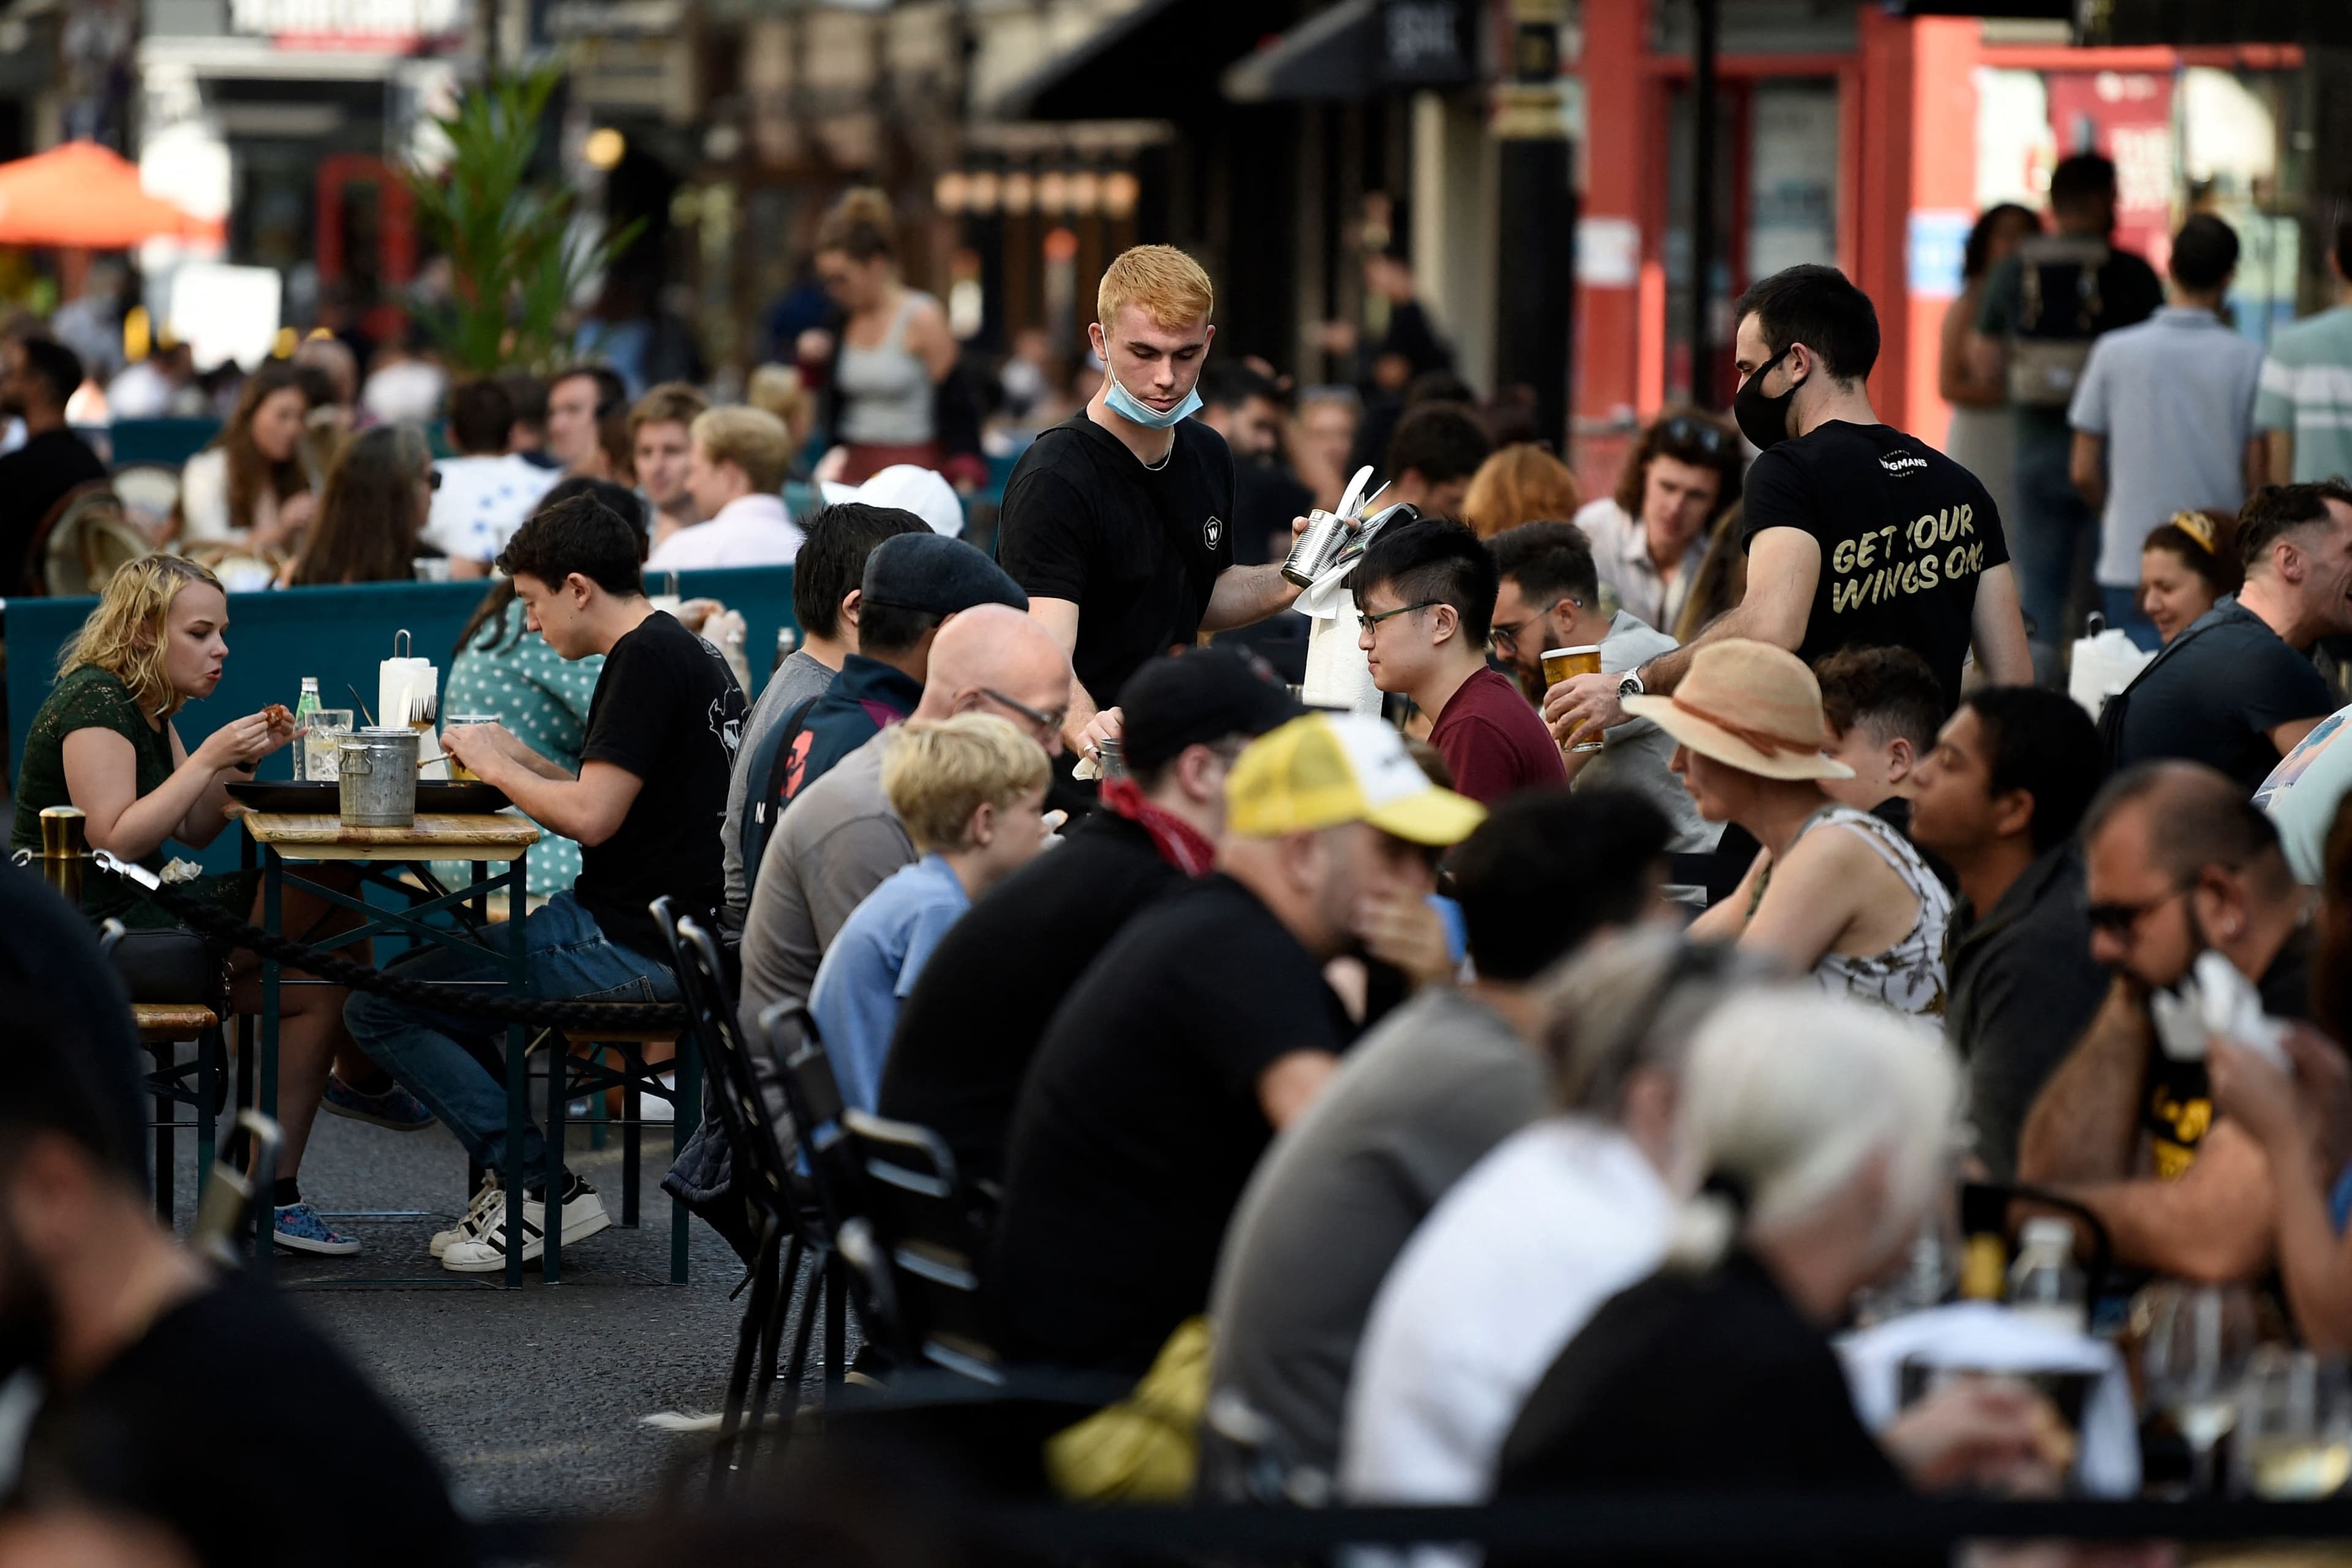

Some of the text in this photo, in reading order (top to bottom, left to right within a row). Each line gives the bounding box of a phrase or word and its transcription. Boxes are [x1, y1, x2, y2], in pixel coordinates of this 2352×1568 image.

[1208, 527, 1218, 541] W
[1833, 503, 1974, 573] GET YOUR
[1833, 554, 1939, 614] WINGS
